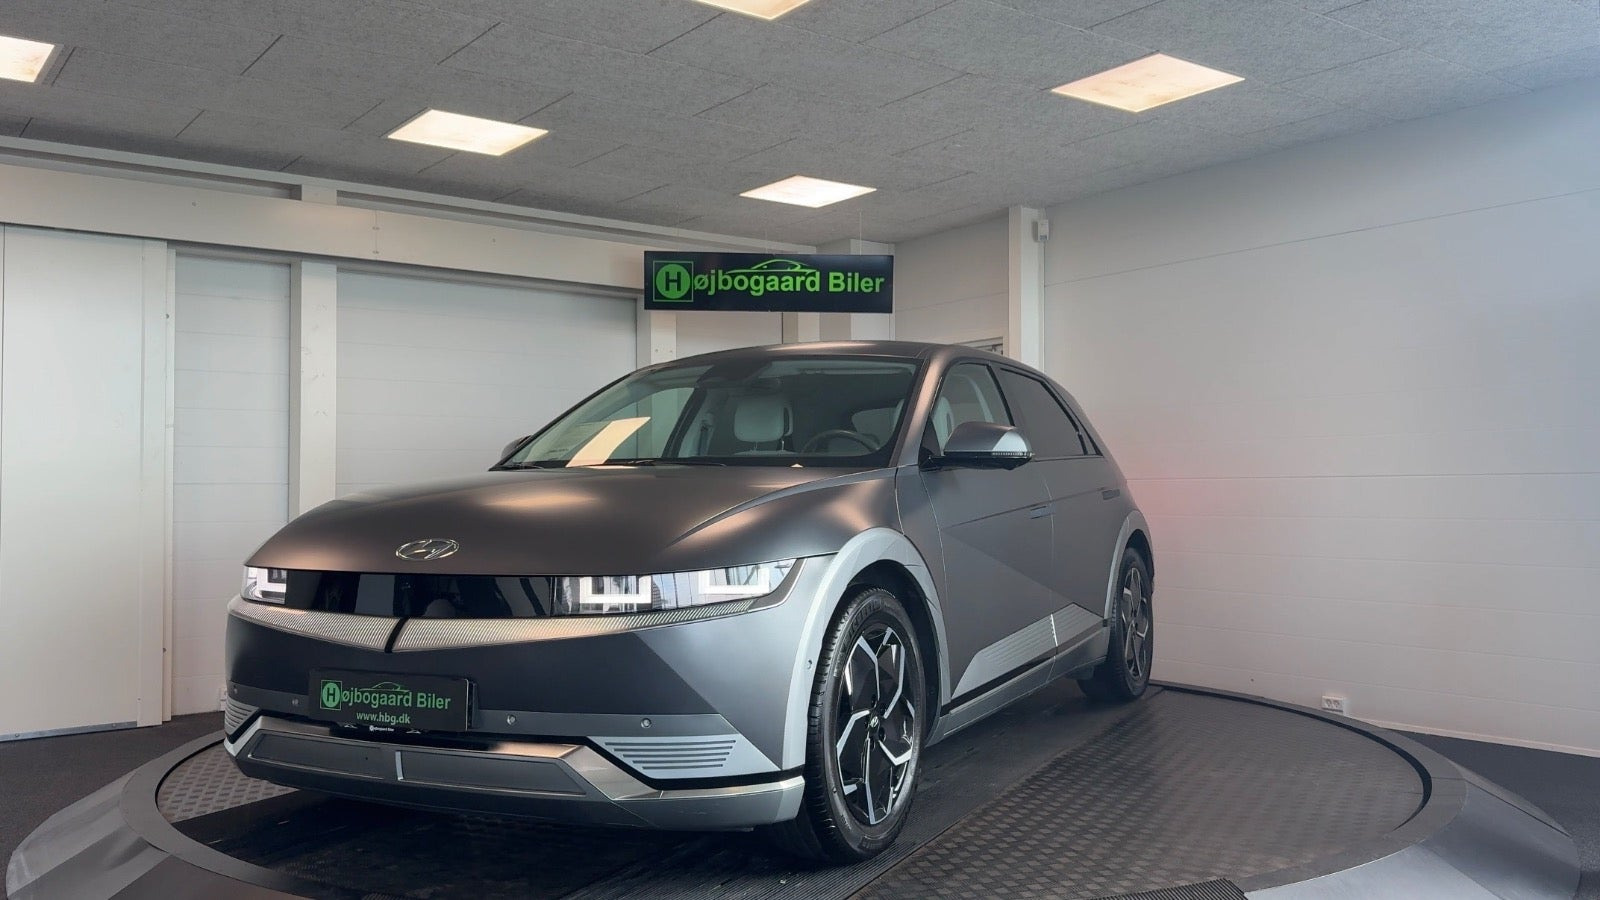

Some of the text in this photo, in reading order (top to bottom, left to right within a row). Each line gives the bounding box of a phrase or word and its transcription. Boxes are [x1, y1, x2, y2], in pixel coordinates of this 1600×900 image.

[828, 271, 885, 293] Biler
[416, 692, 451, 710] Biler
[356, 711, 411, 725] www.hbg.dk
